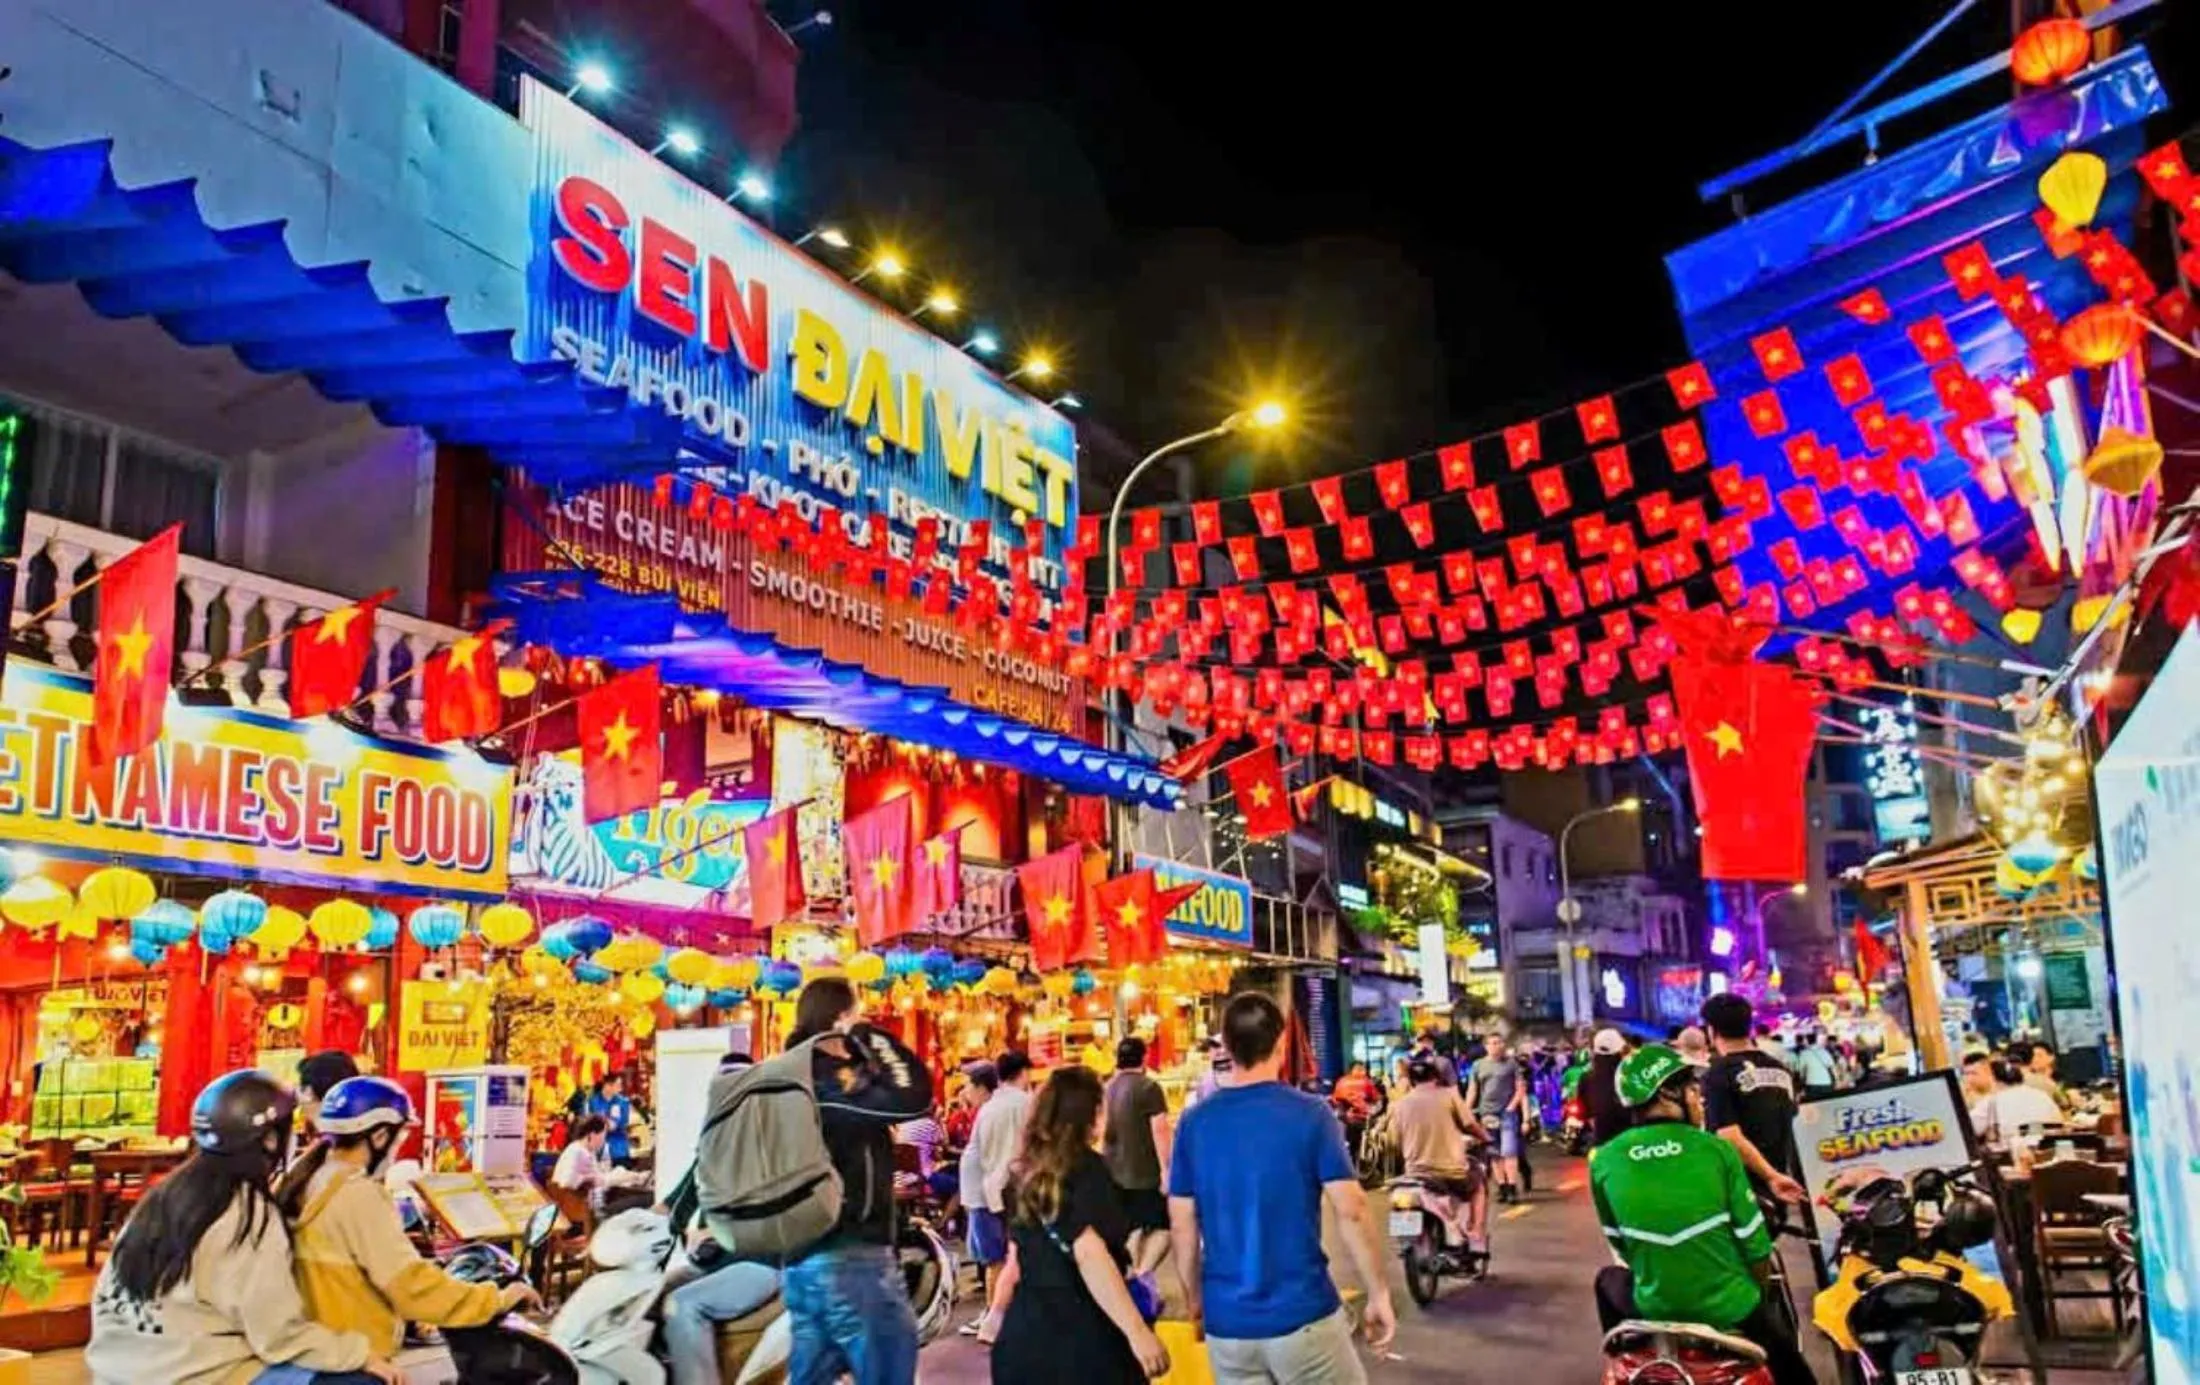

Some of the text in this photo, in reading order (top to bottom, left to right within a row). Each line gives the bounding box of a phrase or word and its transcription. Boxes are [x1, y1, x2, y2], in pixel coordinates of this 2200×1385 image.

[551, 174, 771, 374] SEN
[931, 387, 1073, 528] VIỆT
[551, 325, 750, 447] SEAFOOD
[614, 510, 724, 573] CREAM
[748, 560, 883, 631] SMOOTHIE
[904, 617, 967, 660] JUICE
[984, 647, 1071, 696] COCONUT
[359, 771, 492, 868] FOOD
[1628, 1138, 1683, 1161] Grab
[1817, 1118, 1946, 1163] SEAFOOD
[1835, 1097, 1910, 1131] Fresh
